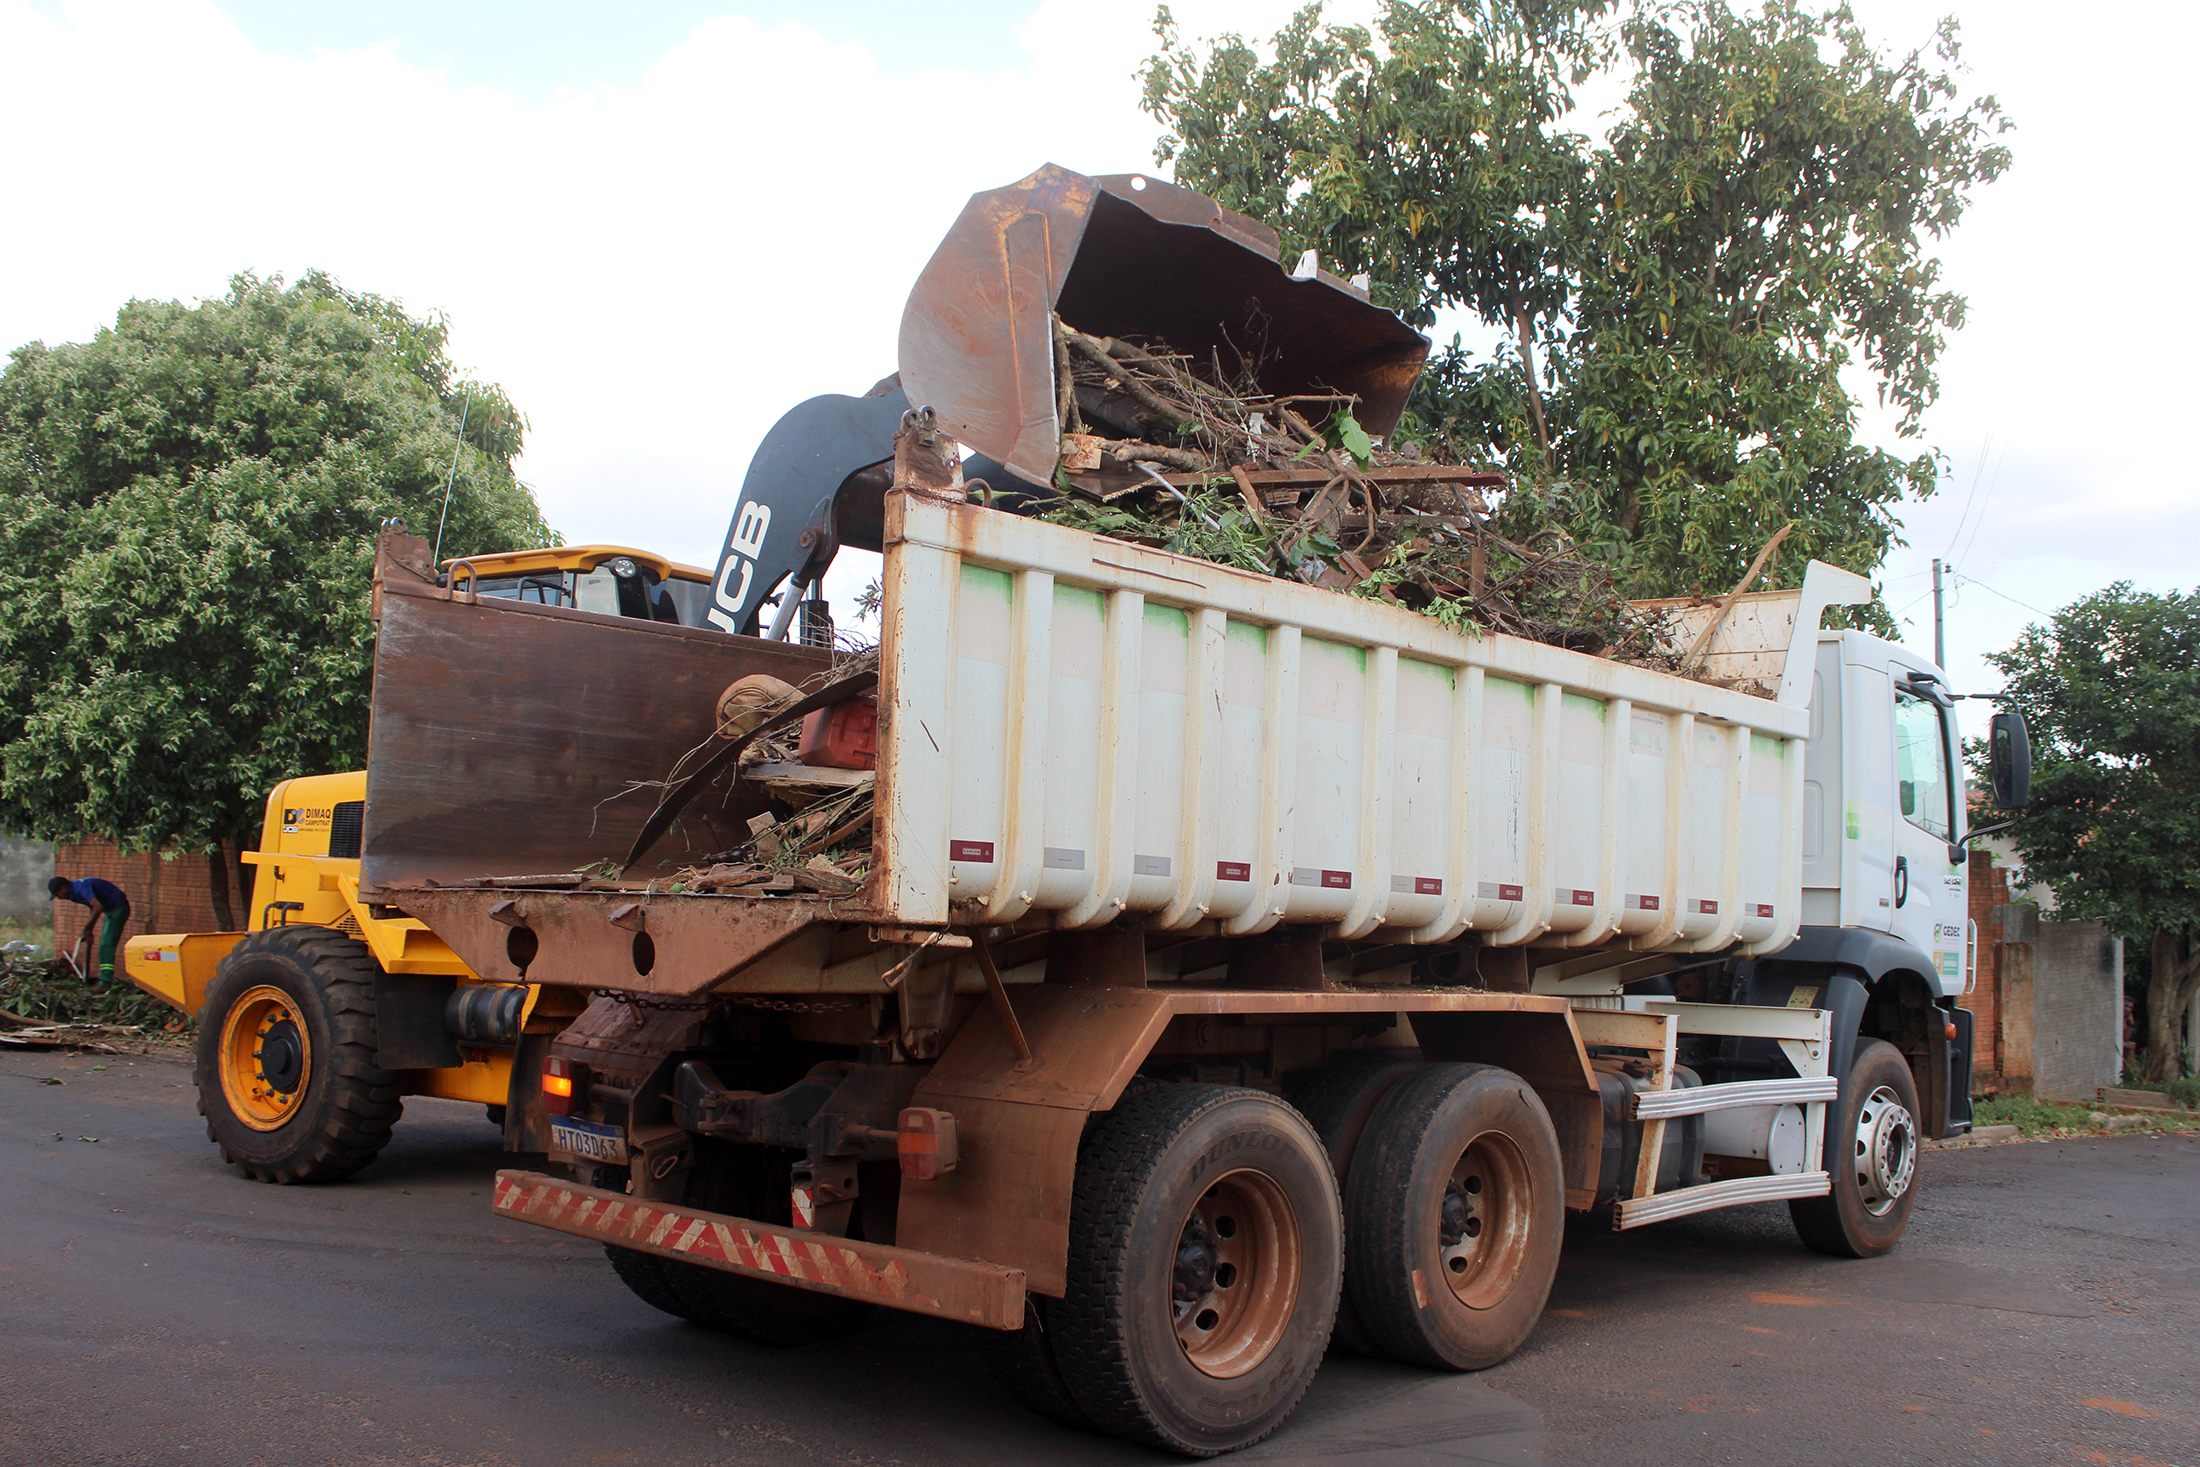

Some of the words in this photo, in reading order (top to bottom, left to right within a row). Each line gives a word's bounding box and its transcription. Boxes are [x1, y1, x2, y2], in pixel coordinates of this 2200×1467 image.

[707, 500, 772, 634] JCB
[283, 826, 298, 834] JCB
[306, 808, 331, 819] DIMAQ
[1190, 1131, 1299, 1187] DUNLOP
